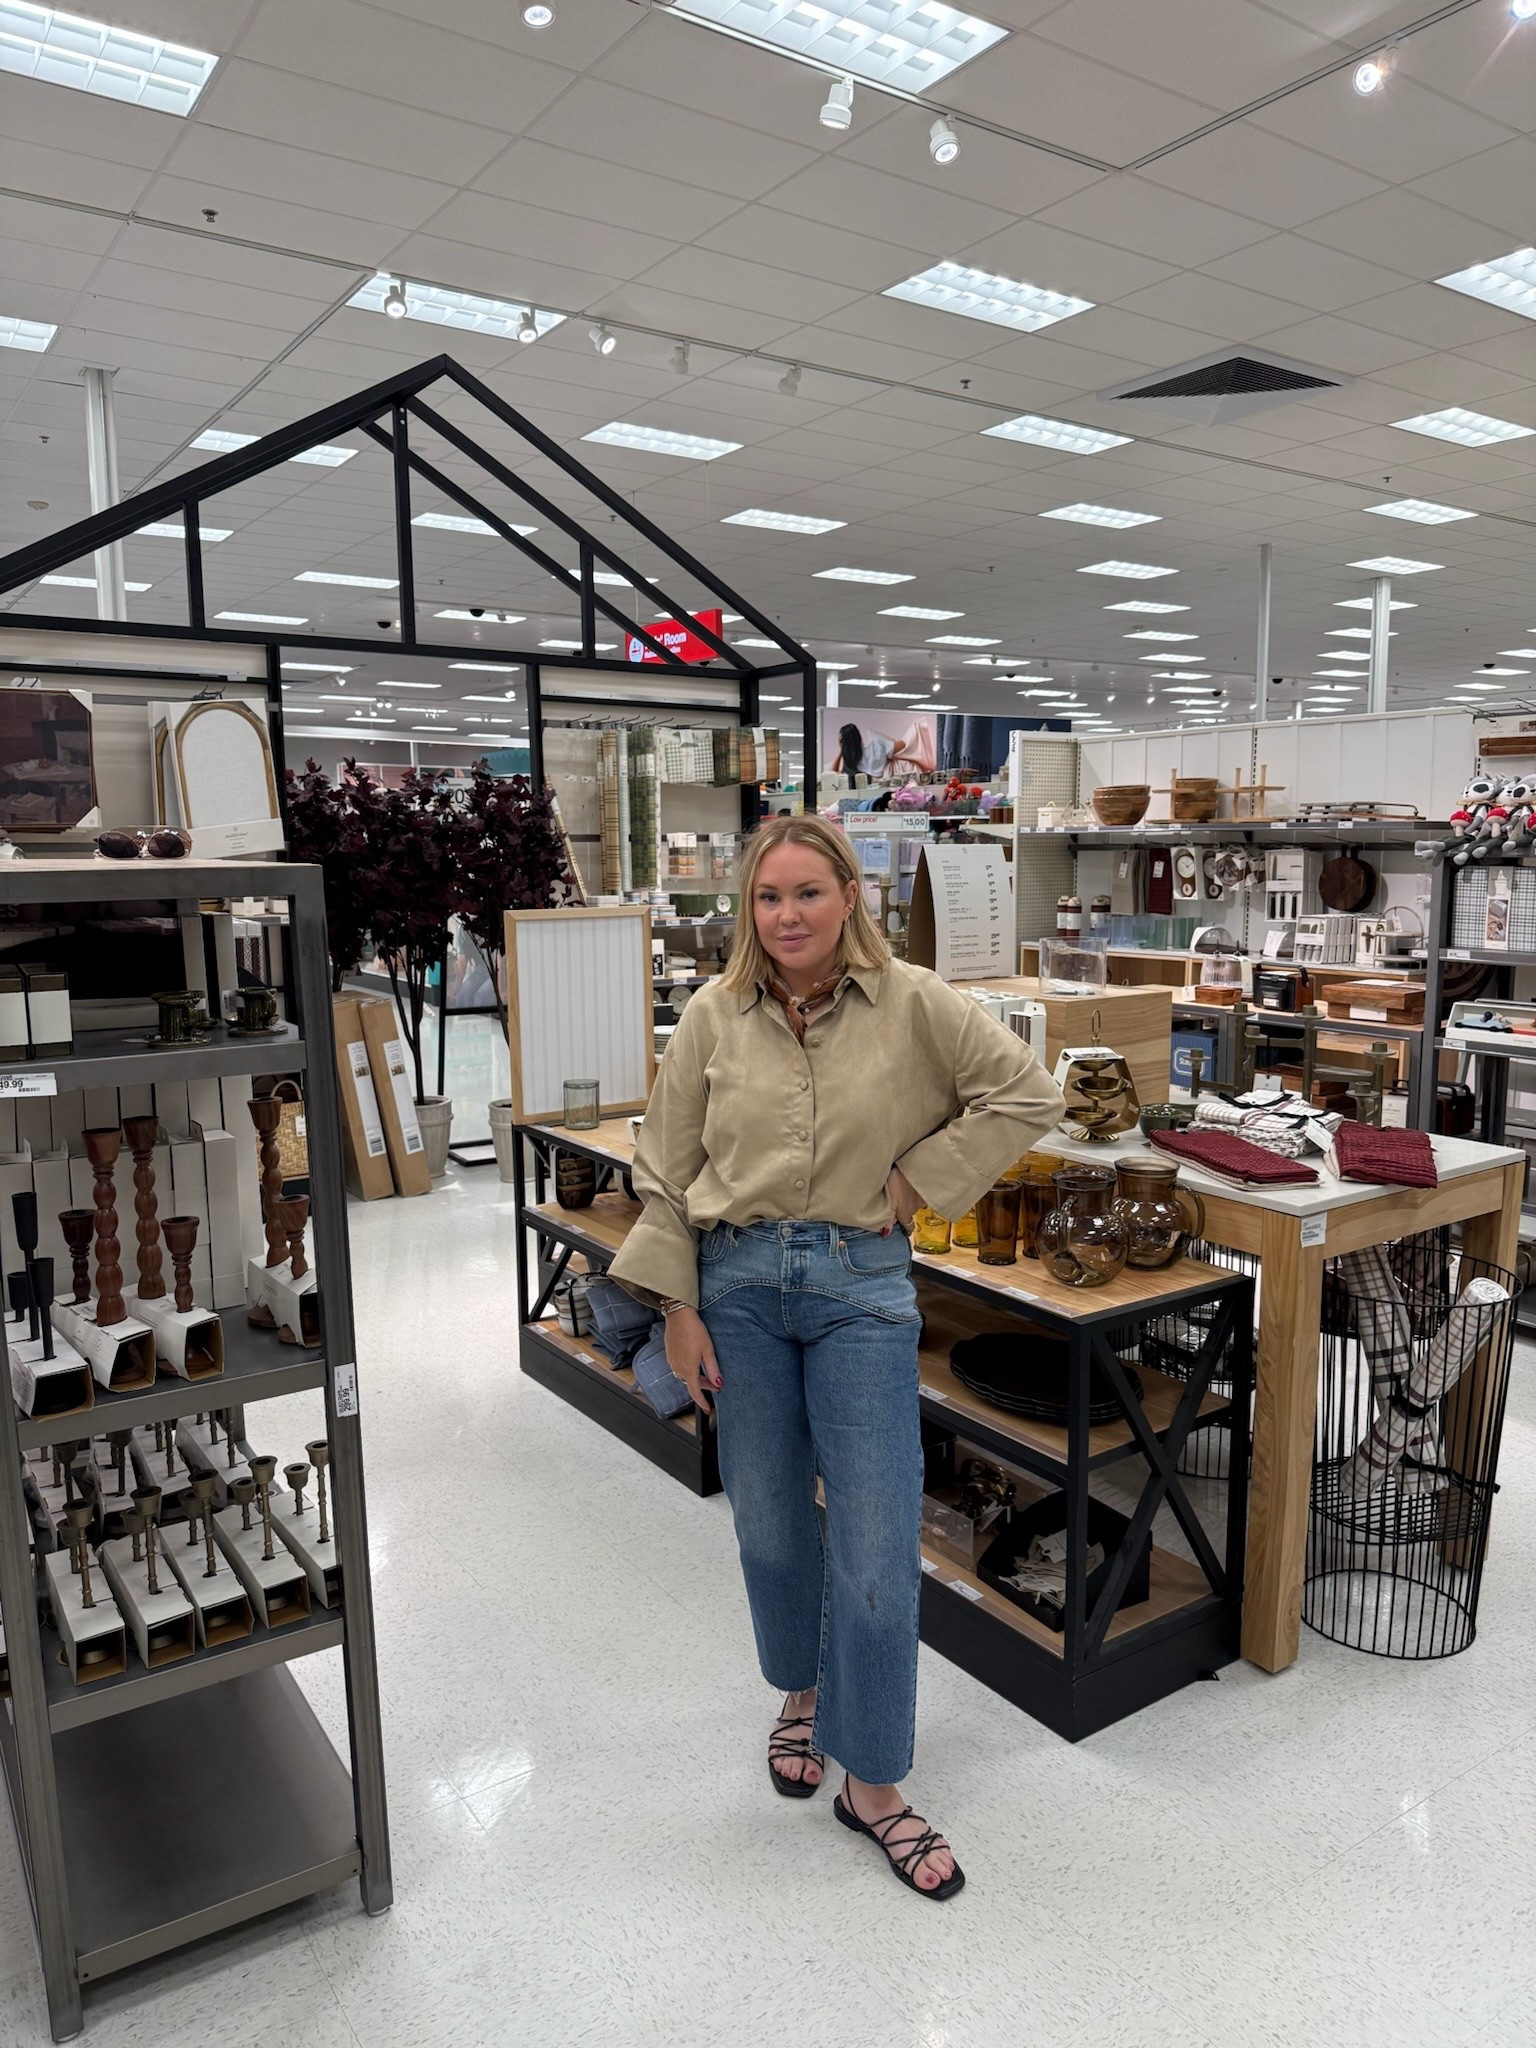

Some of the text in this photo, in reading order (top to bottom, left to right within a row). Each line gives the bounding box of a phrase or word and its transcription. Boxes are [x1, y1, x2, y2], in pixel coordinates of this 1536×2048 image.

[664, 632, 687, 646] Room
[850, 815, 878, 824] Low price!
